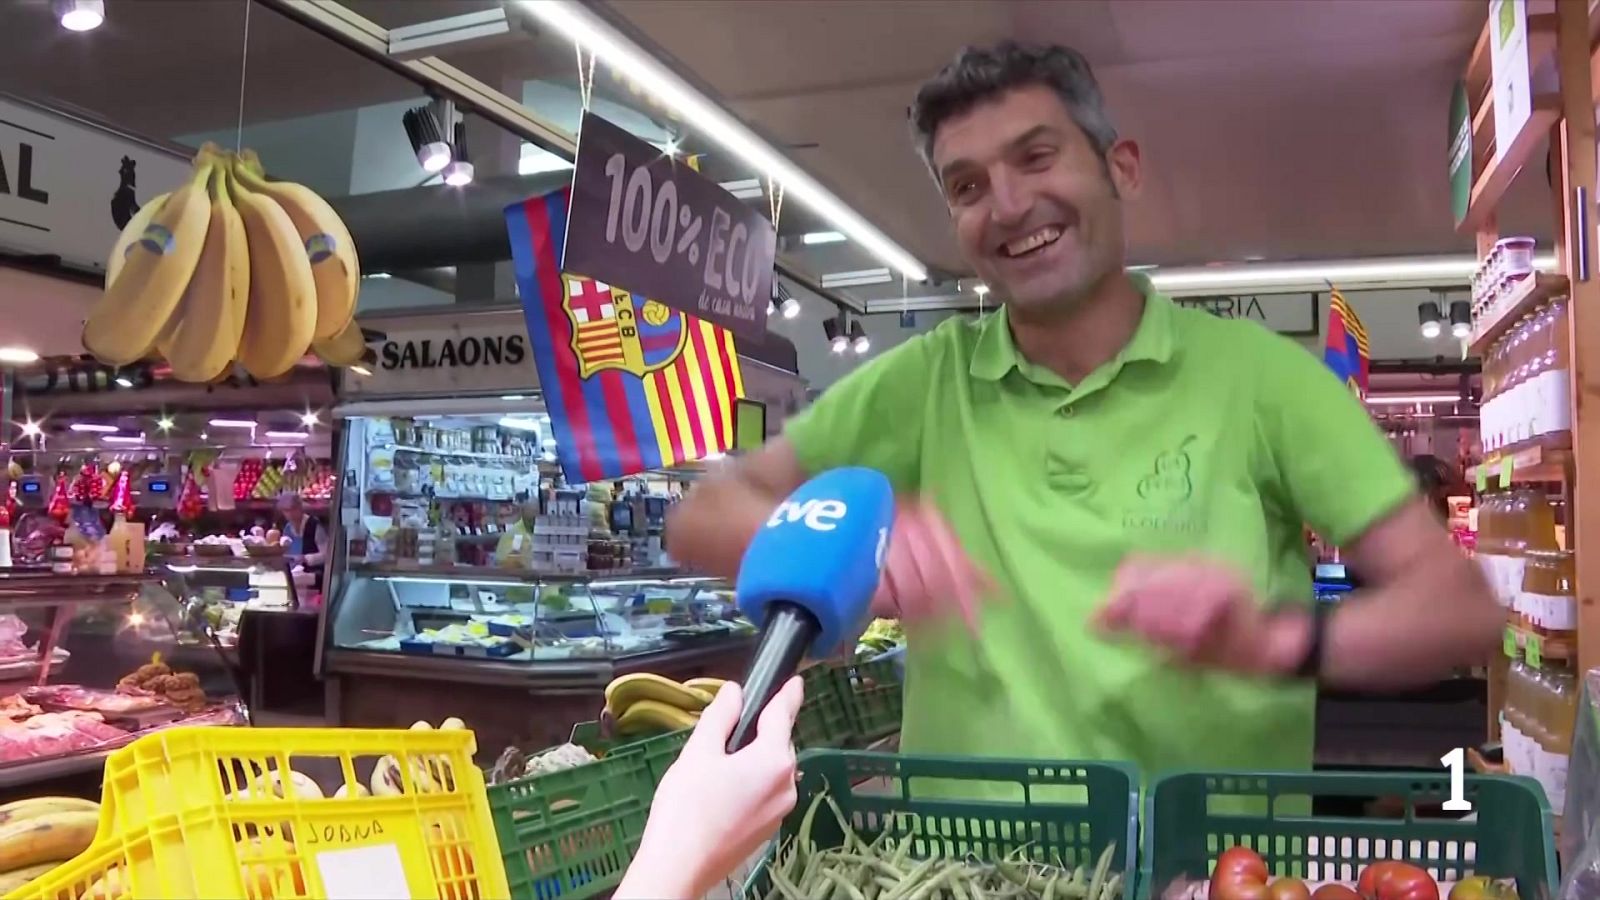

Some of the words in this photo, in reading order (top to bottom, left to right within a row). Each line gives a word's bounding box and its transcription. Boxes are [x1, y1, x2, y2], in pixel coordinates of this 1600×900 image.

[605, 153, 702, 267] 100%
[704, 206, 761, 303] ECO
[614, 294, 635, 337] FCB
[382, 335, 525, 370] SALAONS
